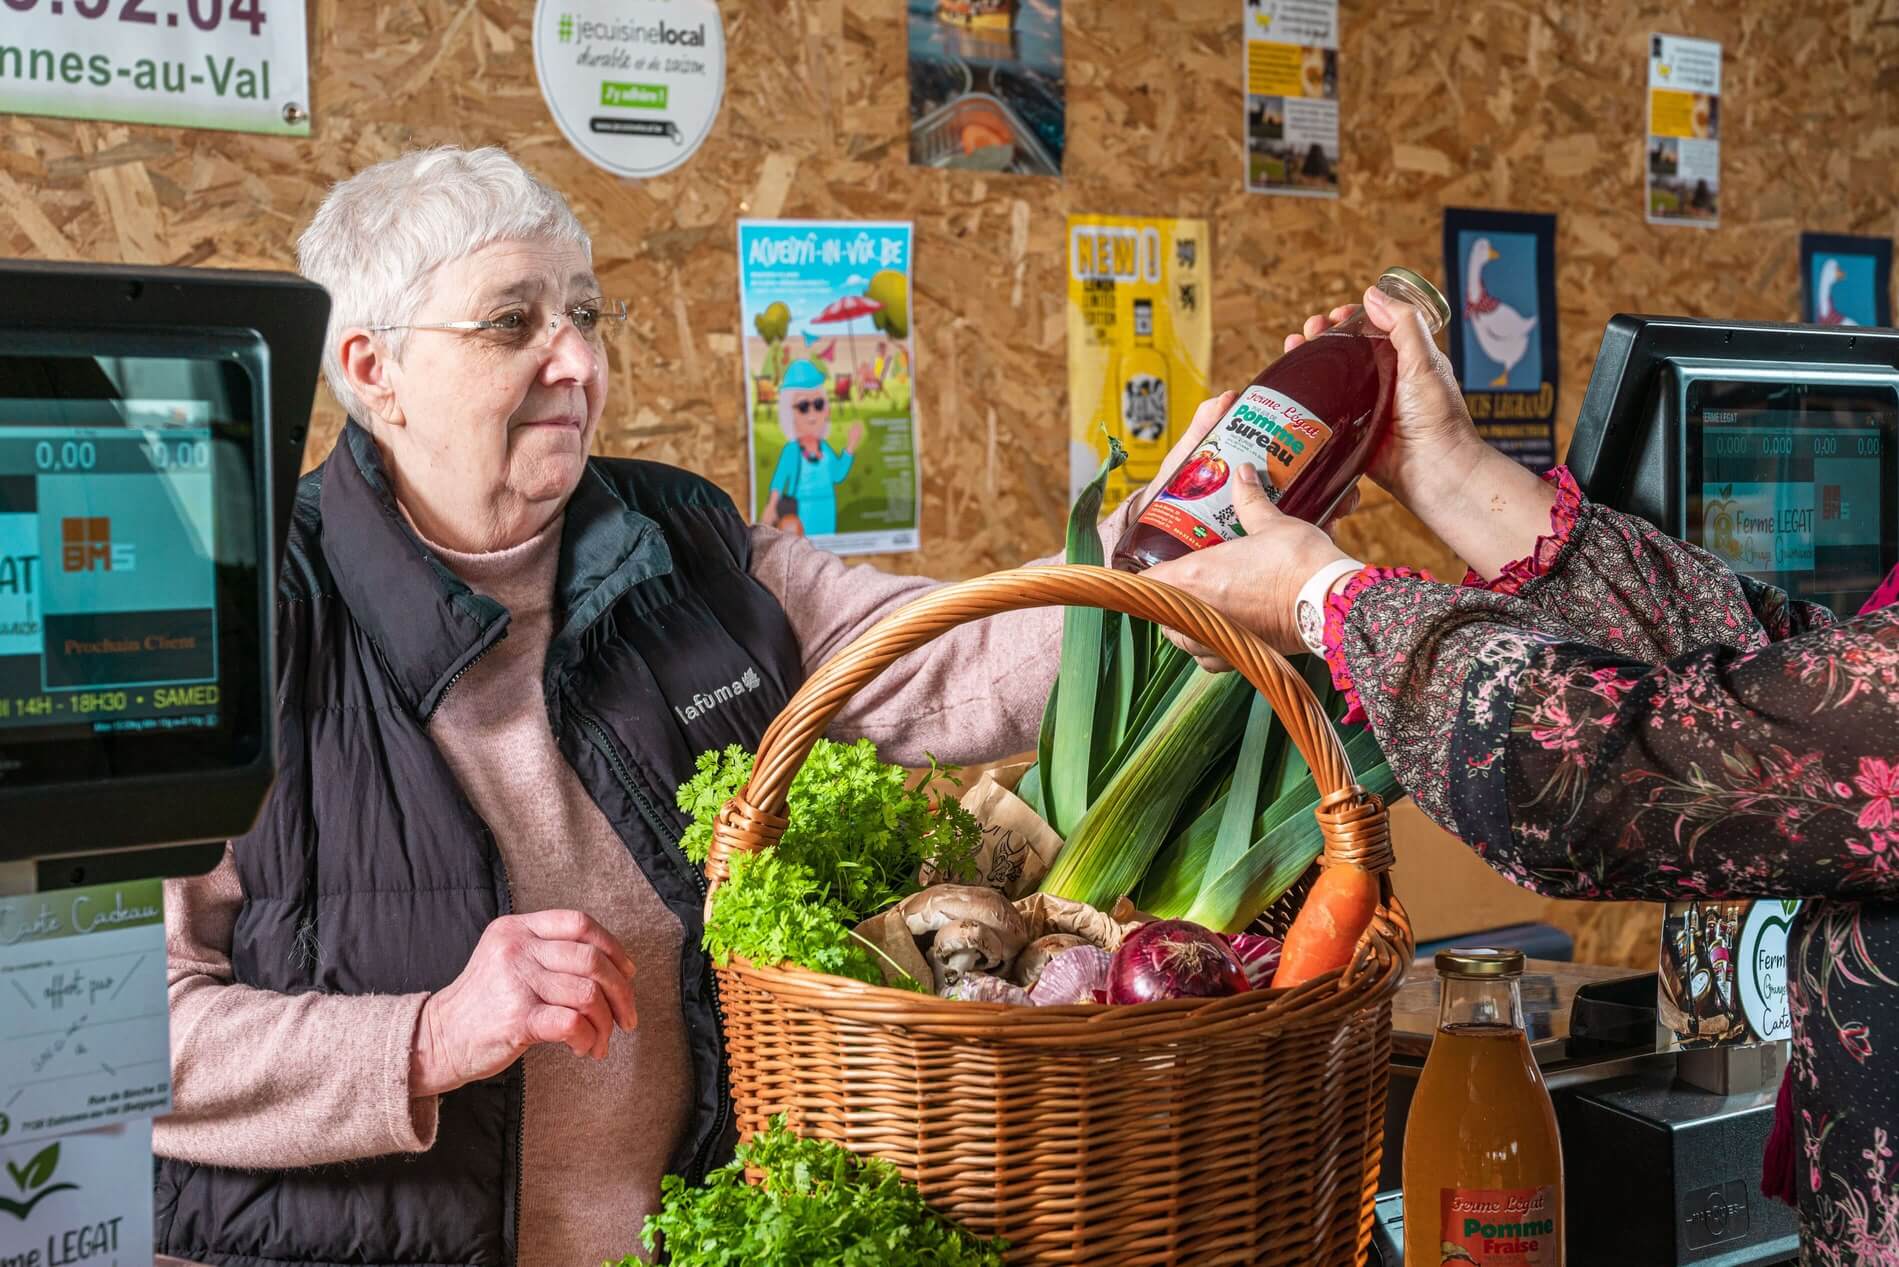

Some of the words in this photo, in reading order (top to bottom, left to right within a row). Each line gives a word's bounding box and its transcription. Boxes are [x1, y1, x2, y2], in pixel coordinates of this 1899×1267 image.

[557, 13, 705, 47] #jecuisinelocal
[35, 440, 96, 471] 0,00
[1226, 417, 1294, 467] Sureau
[1735, 510, 1774, 534] Ferme
[1776, 508, 1815, 534] LEGAT
[15, 698, 51, 717] 14H
[70, 692, 127, 713] 18H30
[153, 686, 219, 709] SAMED
[674, 680, 745, 725] lafuma
[71, 890, 160, 934] Cadeau
[47, 1216, 124, 1267] LEGAT
[1464, 1218, 1553, 1239] Pomme
[1483, 1239, 1539, 1254] Fraise
